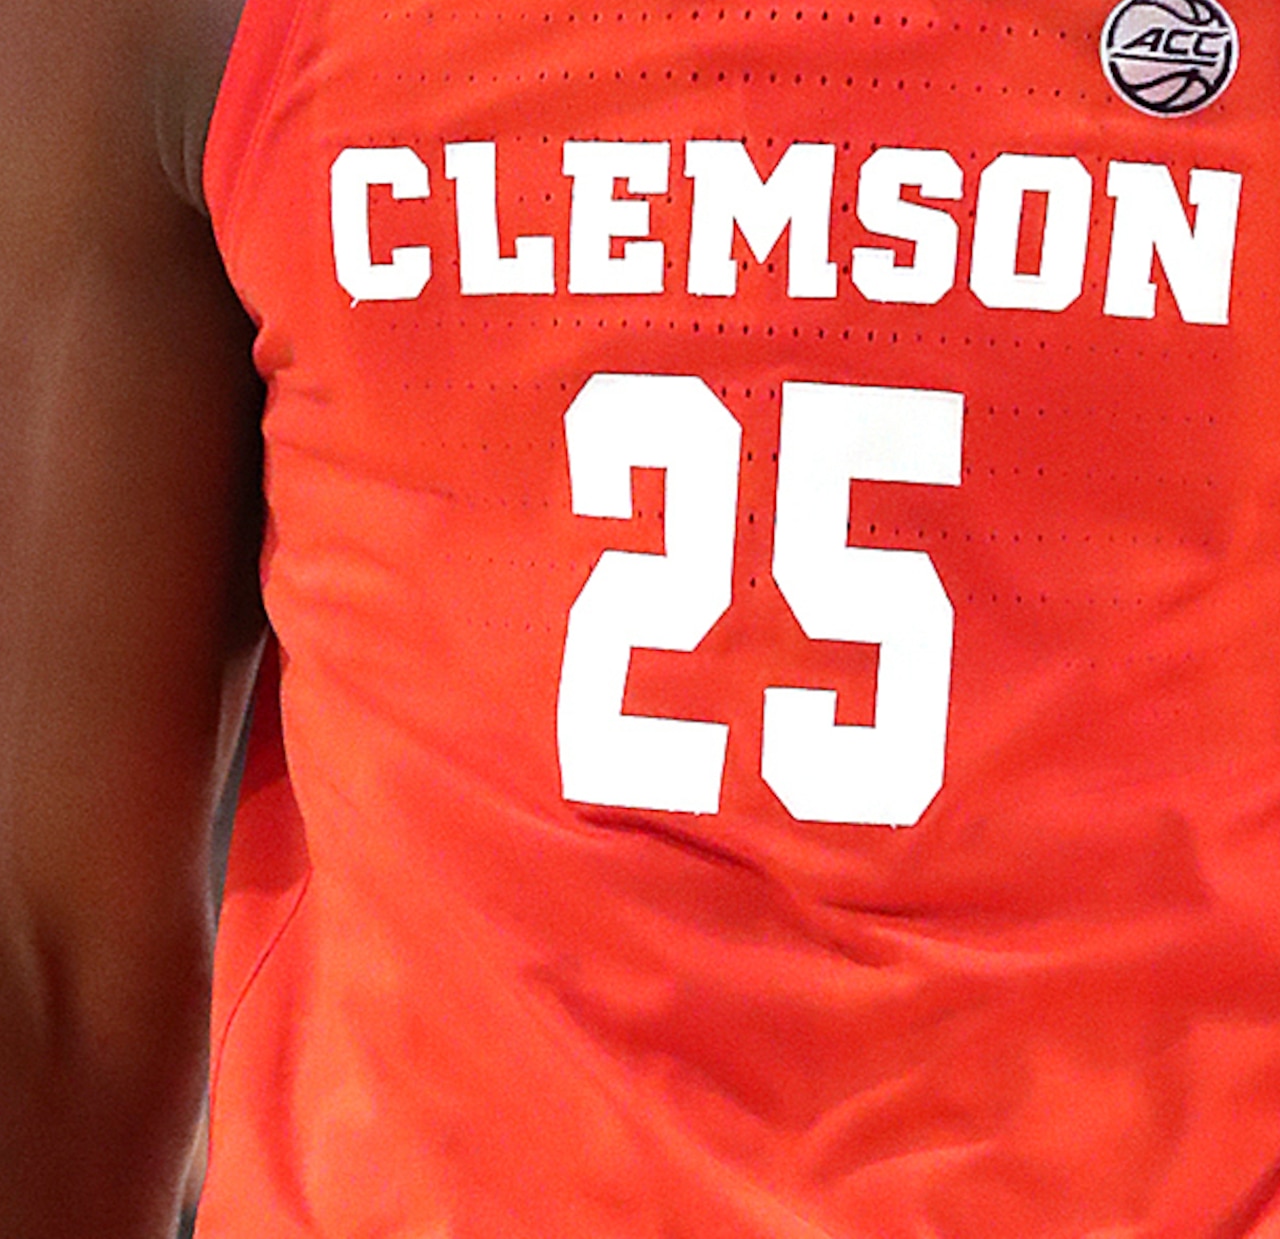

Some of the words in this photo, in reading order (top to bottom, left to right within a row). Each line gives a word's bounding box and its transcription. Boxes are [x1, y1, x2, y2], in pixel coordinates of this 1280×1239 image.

[1122, 27, 1230, 58] ACC
[330, 140, 1241, 325] CLEMSON
[556, 372, 965, 827] 25
